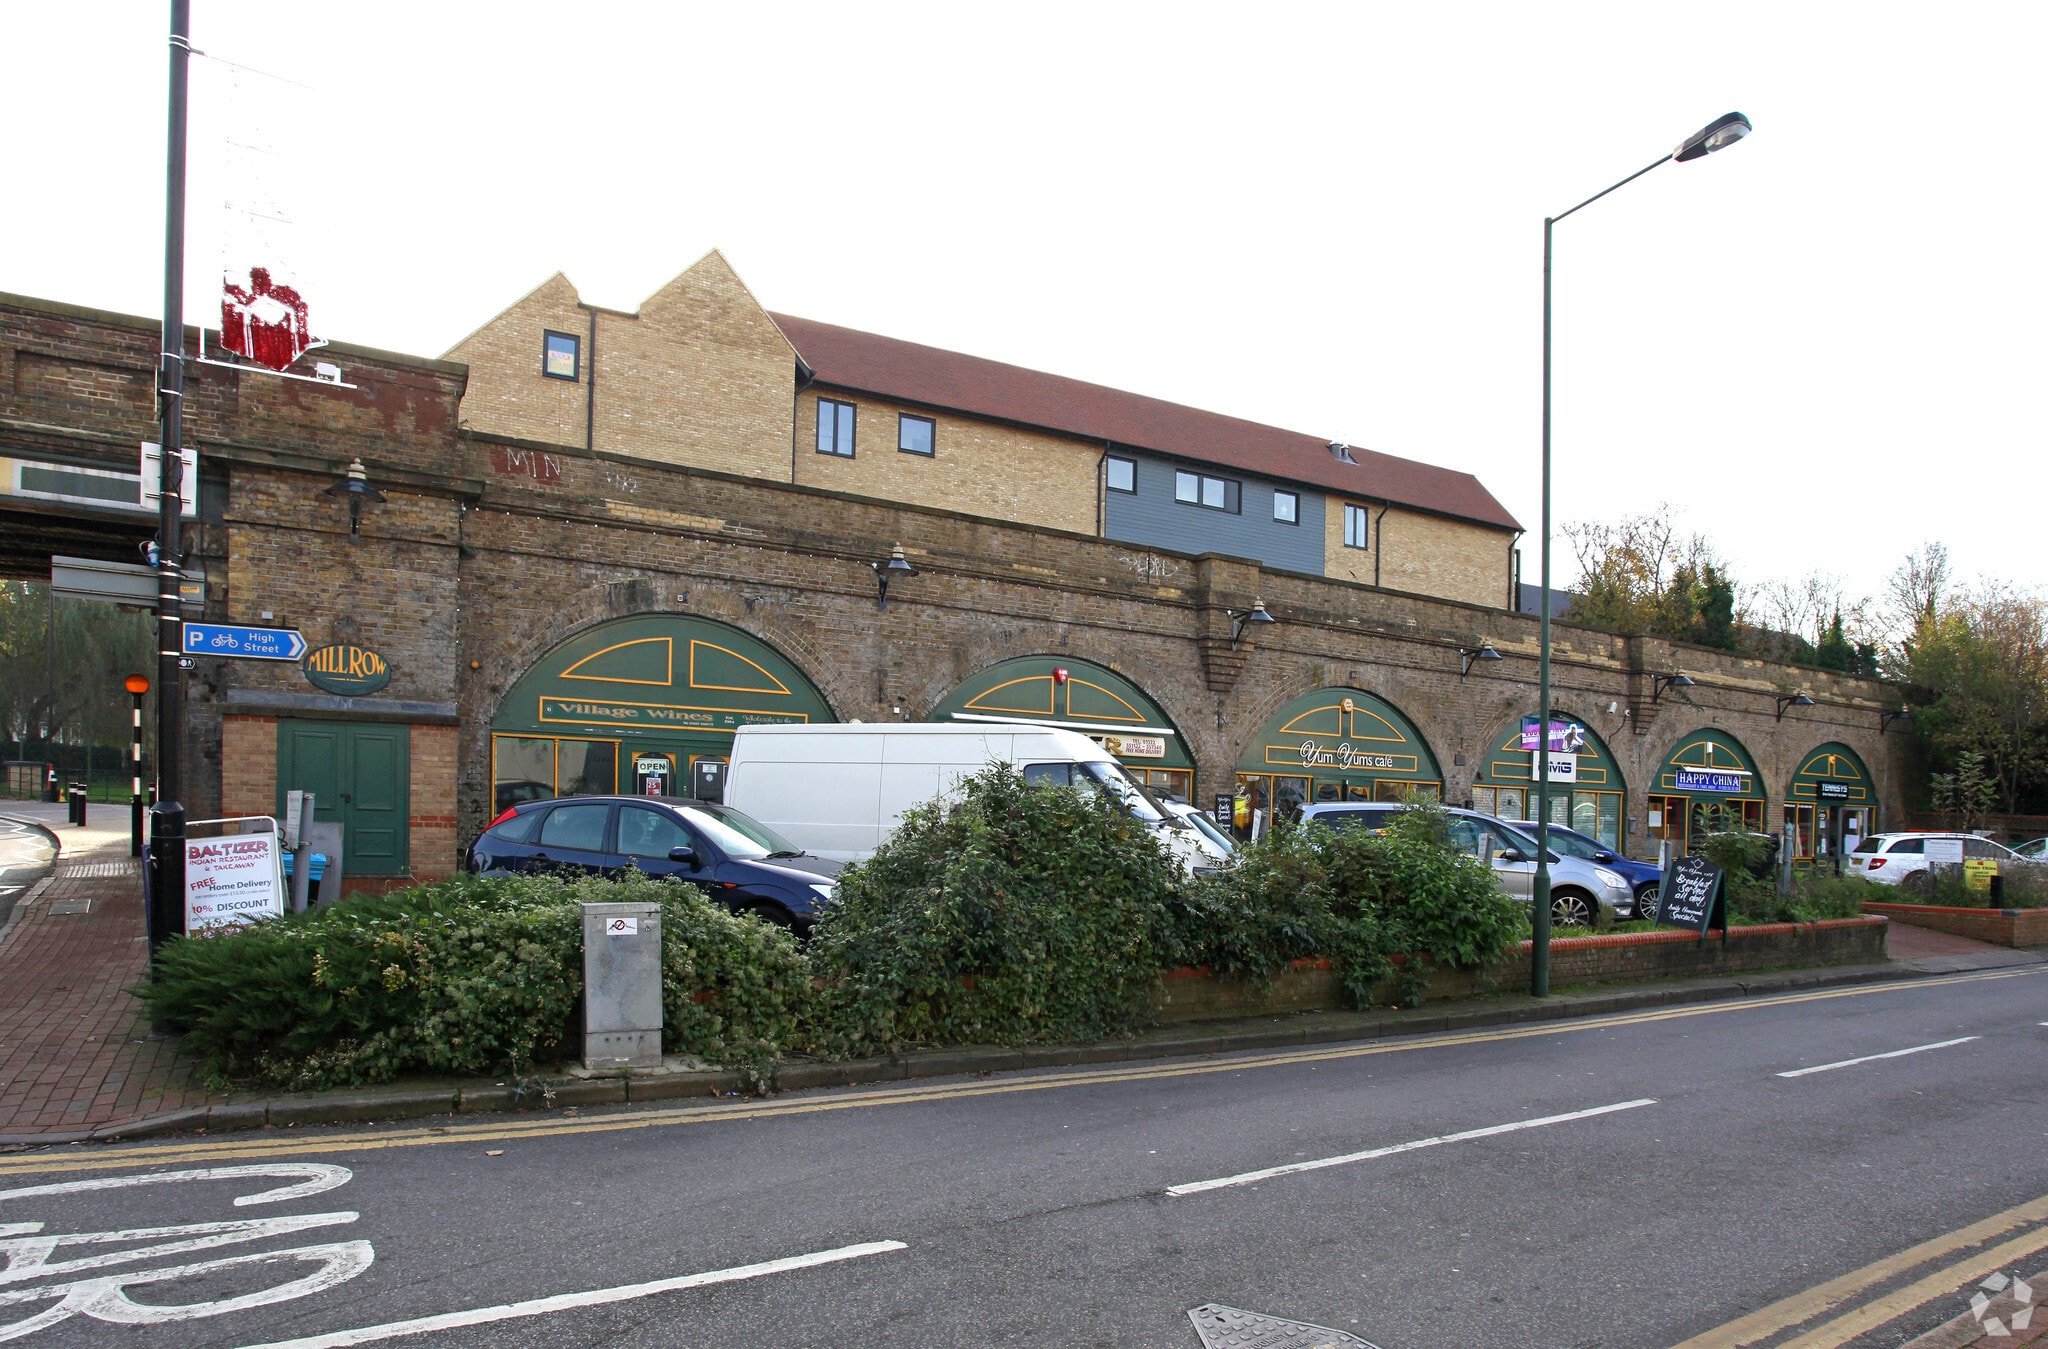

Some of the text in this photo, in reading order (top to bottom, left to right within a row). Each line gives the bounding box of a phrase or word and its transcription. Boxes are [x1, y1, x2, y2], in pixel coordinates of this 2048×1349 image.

[189, 631, 204, 646] P
[249, 632, 275, 644] High
[244, 642, 279, 653] Street
[558, 703, 638, 718] Village
[646, 709, 714, 721] Wines
[1300, 740, 1393, 770] Yum Yums café
[640, 763, 666, 771] OPEN
[1679, 772, 1739, 787] HAPPY CHINA
[188, 840, 269, 859] BALTIZER
[189, 853, 269, 866] INDIAN RESTAURANT
[190, 877, 217, 891] FREE
[209, 880, 272, 891] Home Delivery
[1674, 891, 1688, 902] all
[192, 899, 269, 913] 10% DISCOUNT
